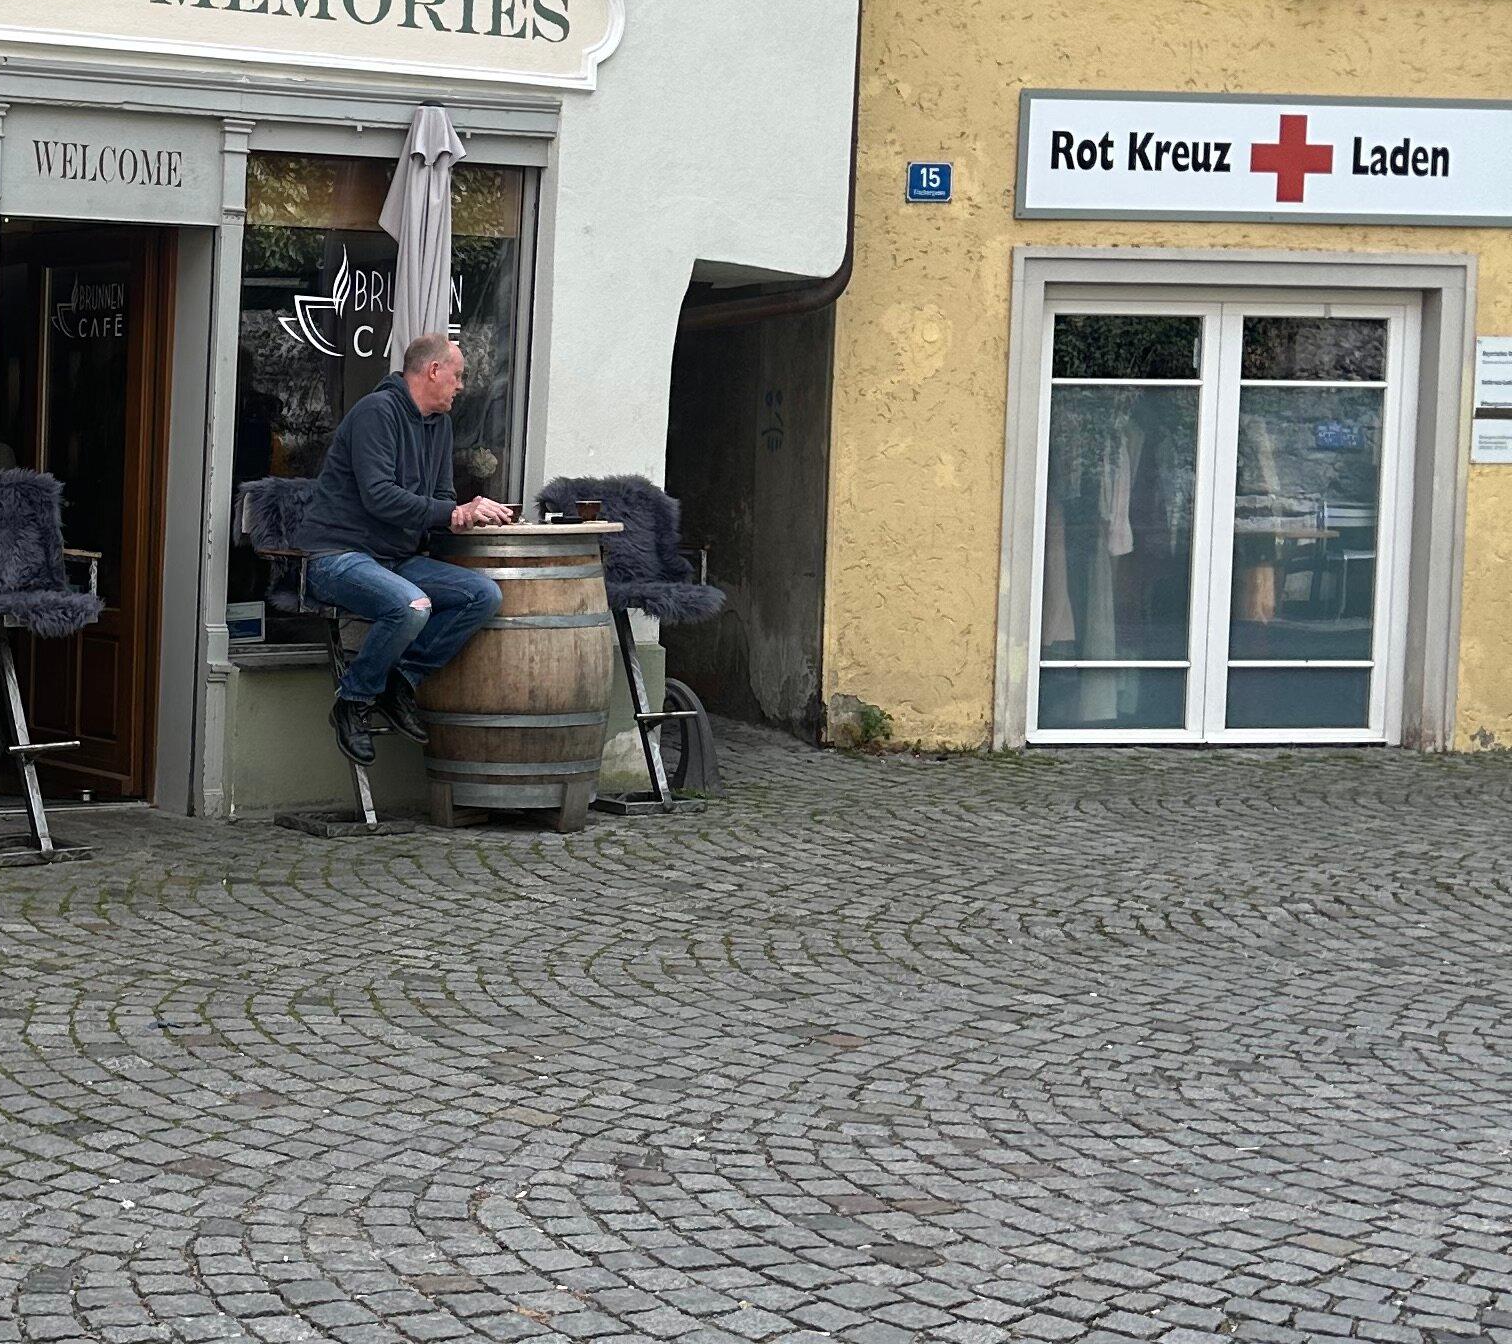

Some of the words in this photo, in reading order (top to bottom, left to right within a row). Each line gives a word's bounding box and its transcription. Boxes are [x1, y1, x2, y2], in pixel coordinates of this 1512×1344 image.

[32, 139, 182, 188] WELCOME
[1050, 130, 1115, 171] Rot
[1127, 131, 1232, 173] Kreuz
[1352, 136, 1450, 177] Laden
[920, 167, 941, 188] 15
[79, 283, 124, 311] BRUNNEN
